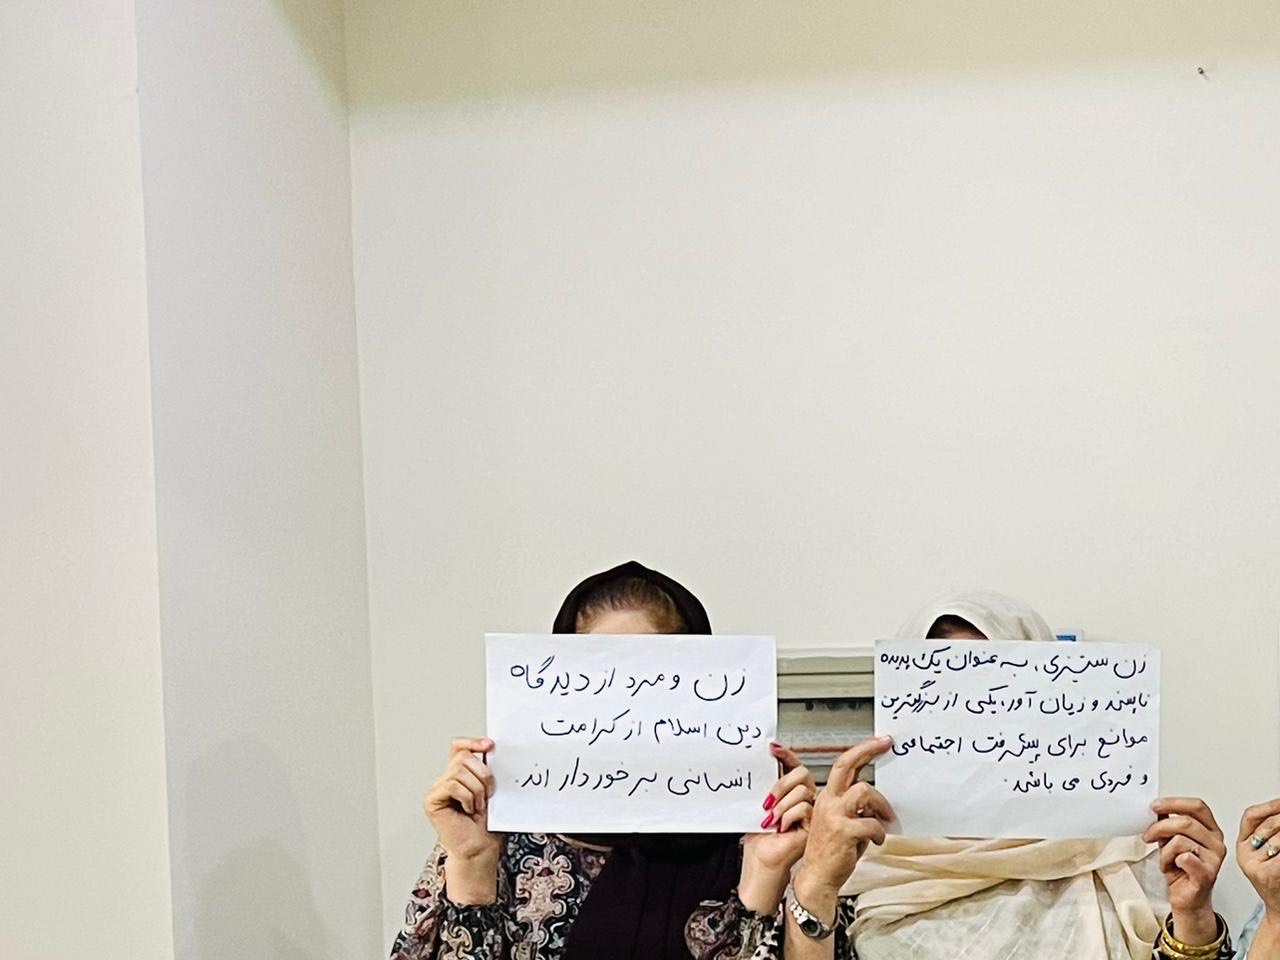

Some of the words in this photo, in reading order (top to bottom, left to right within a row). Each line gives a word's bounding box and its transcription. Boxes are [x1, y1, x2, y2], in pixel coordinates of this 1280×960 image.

[881, 653, 910, 670] پدیده
[912, 646, 951, 674] یک
[946, 650, 998, 671] عنوان
[1000, 660, 1028, 677] به
[1113, 654, 1147, 679] زن
[510, 655, 590, 696] دیدگاه
[593, 667, 615, 695] از
[626, 674, 665, 697] مرد
[669, 674, 680, 690] و
[694, 666, 746, 701] زن
[942, 692, 958, 711] از
[965, 685, 1009, 714] یکی
[1040, 693, 1086, 716] زیان
[1091, 700, 1098, 711] و
[541, 709, 633, 746] کرامت
[623, 721, 642, 740] از
[654, 718, 707, 744] اسلام
[716, 725, 761, 749] دین
[891, 736, 962, 756] اجتماعی
[1047, 734, 1086, 758] برای
[1098, 728, 1148, 759] موانع
[667, 767, 752, 796] انسانی
[1062, 778, 1080, 791] می
[1091, 765, 1132, 793] فردی
[1140, 774, 1148, 785] و
